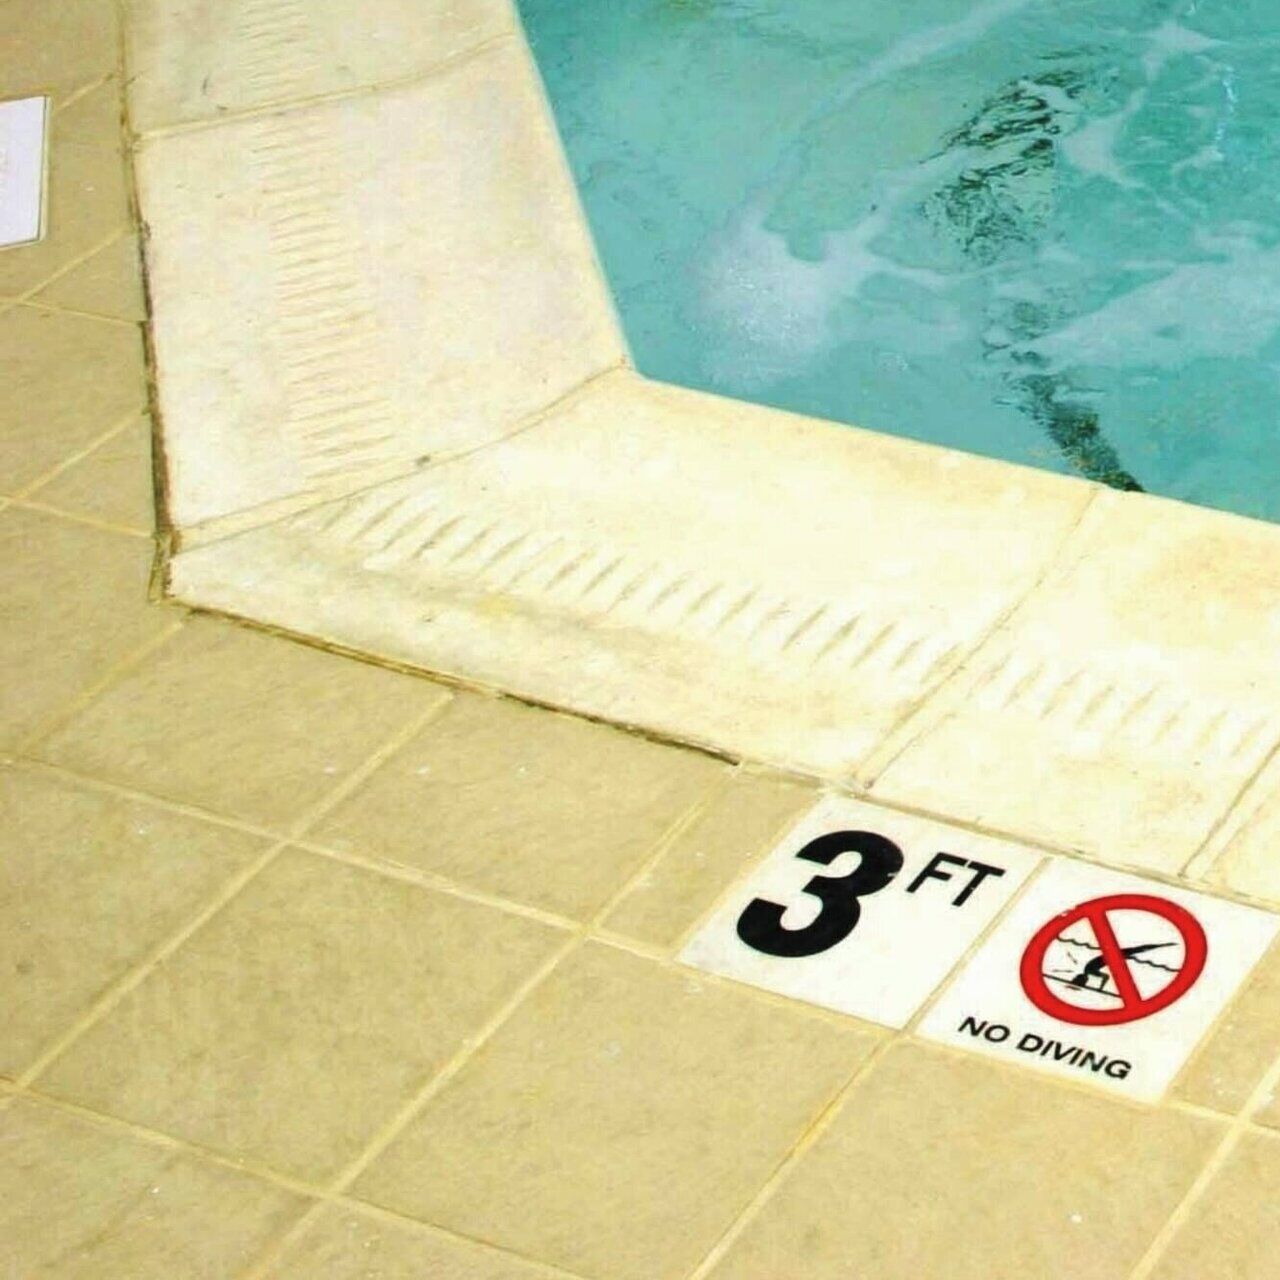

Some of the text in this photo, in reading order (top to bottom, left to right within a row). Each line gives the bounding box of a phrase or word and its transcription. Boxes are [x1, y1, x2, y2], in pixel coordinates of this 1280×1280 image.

[736, 830, 1006, 958] 3 FT
[958, 1016, 1133, 1080] NO DIVING
